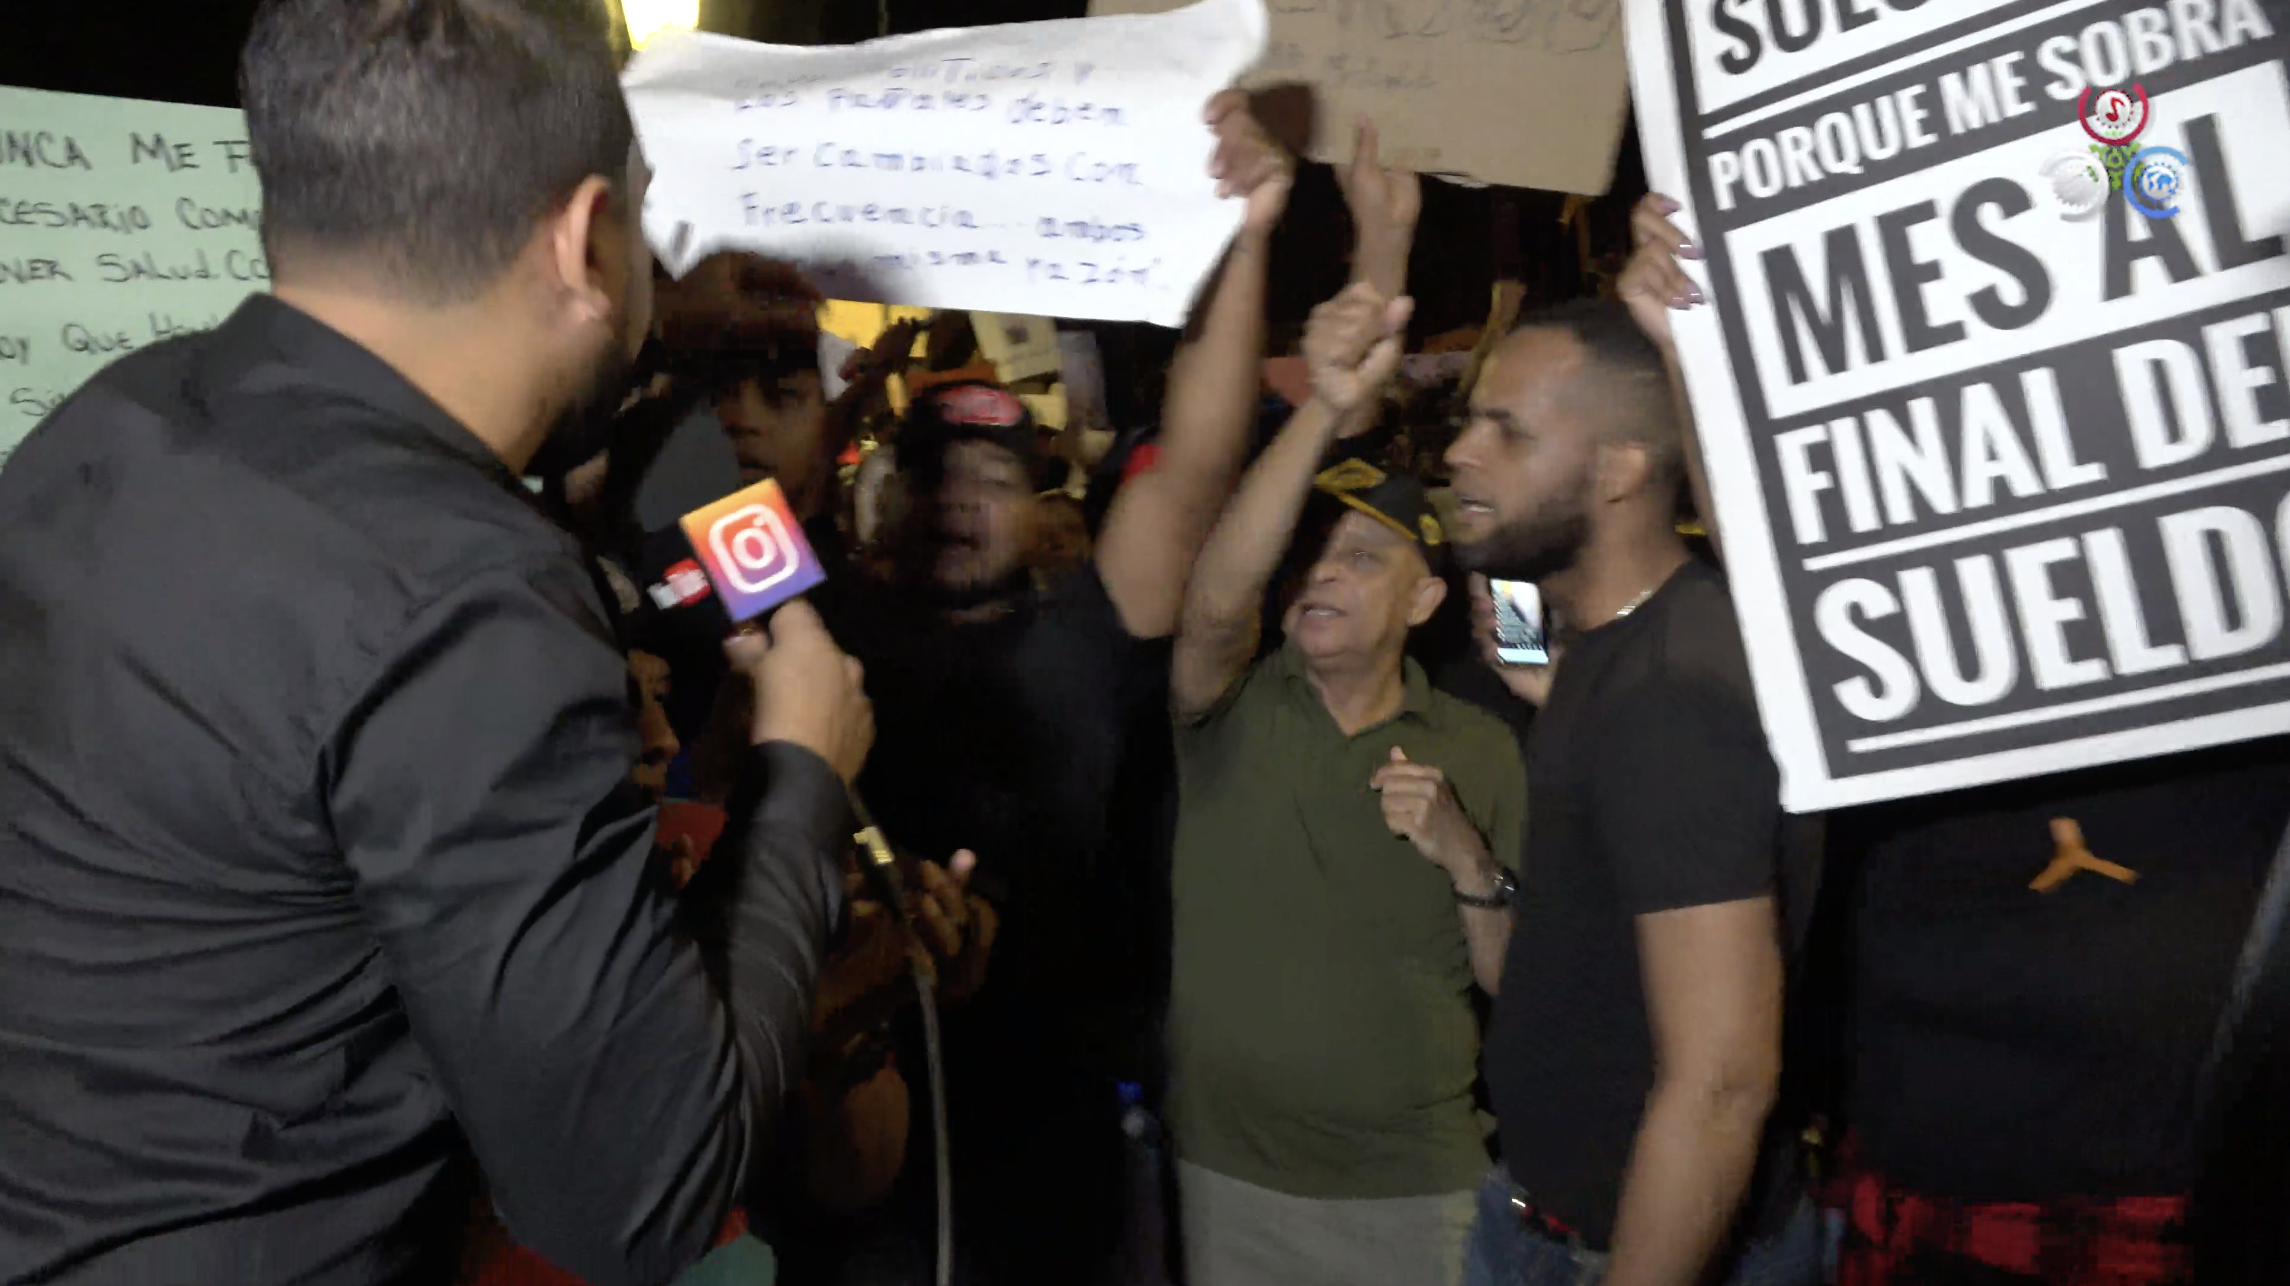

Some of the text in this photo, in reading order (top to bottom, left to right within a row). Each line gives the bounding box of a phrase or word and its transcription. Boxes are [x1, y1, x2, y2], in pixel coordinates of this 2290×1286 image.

[128, 131, 200, 173] ME
[1709, 0, 2276, 211] PORQUE ME SOBRA
[1757, 111, 2288, 387] MES AL
[1774, 366, 2108, 546] FINAL
[1815, 502, 2290, 723] SUELD
